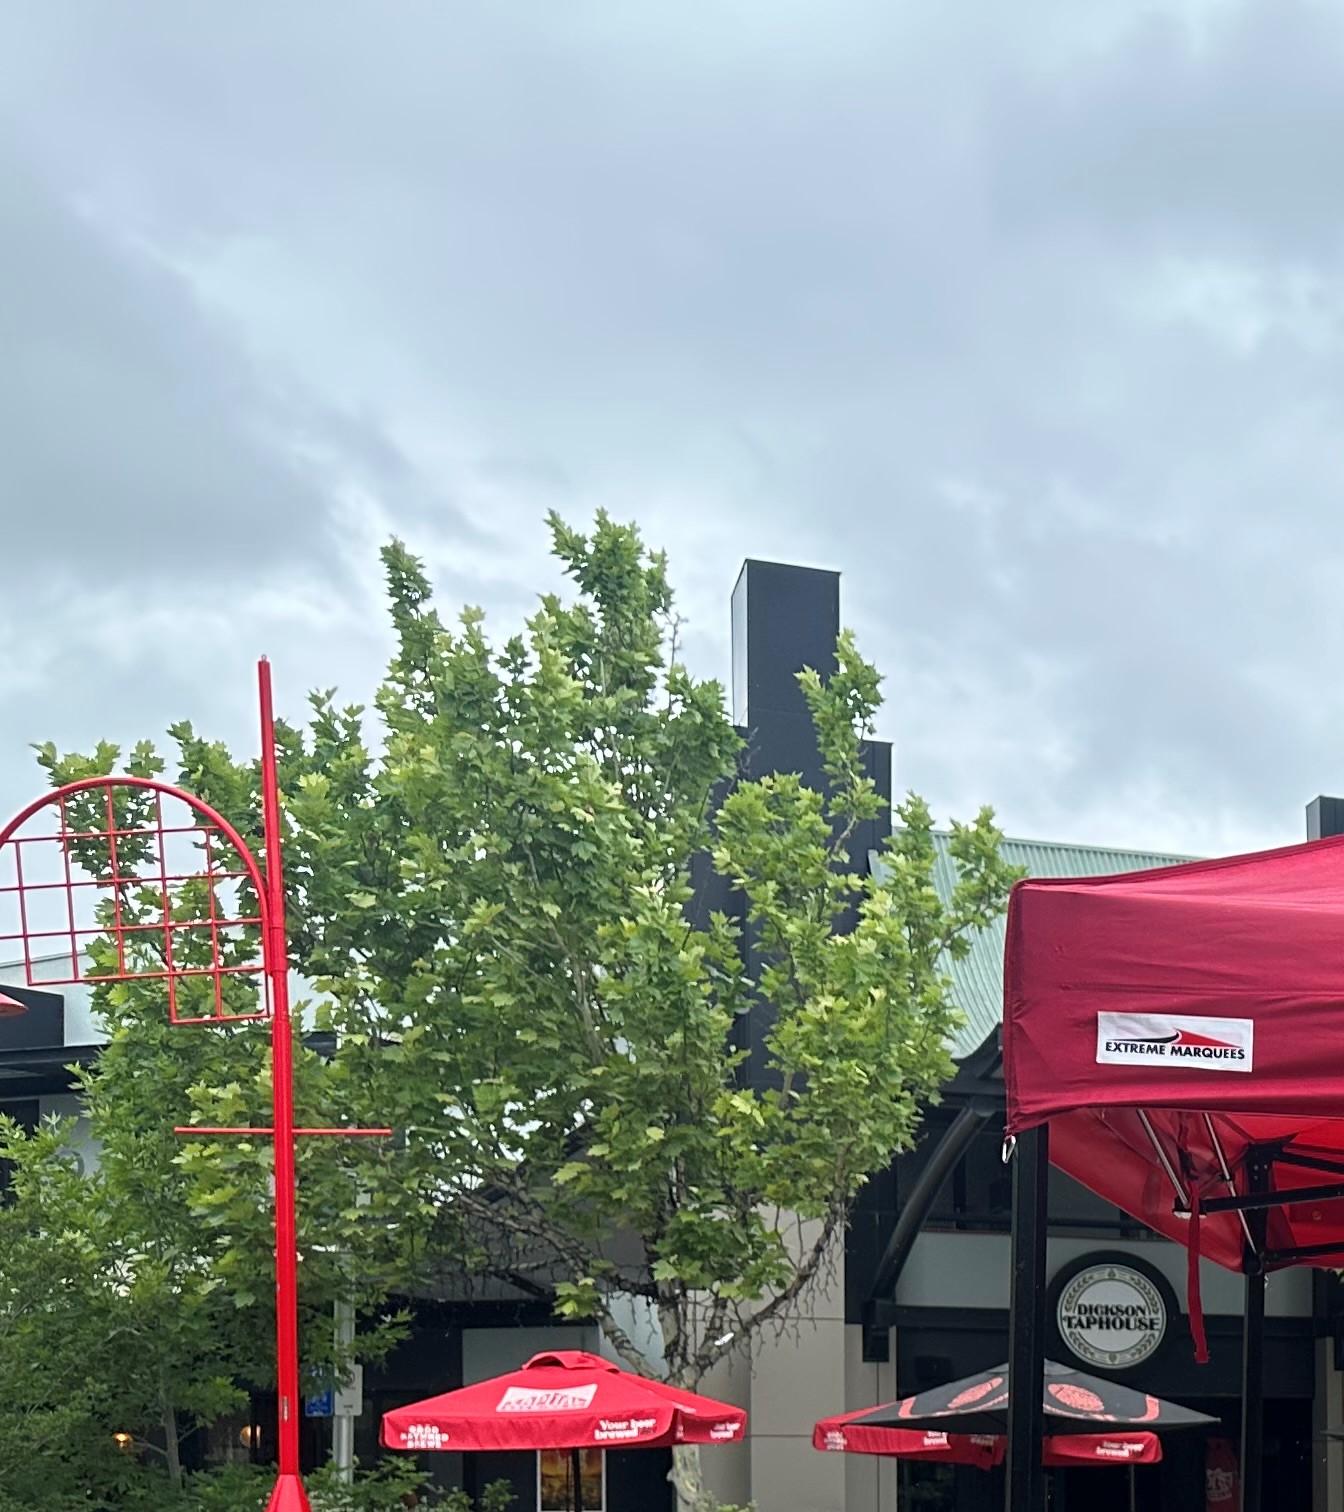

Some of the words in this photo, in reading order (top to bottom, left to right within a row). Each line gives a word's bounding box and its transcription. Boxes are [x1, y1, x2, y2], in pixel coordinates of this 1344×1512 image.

[1105, 1041, 1166, 1055] EXTREME
[1170, 1045, 1246, 1060] MARQUEES
[1077, 1304, 1146, 1316] DICKSON
[1062, 1315, 1160, 1331] TAPHOUSE
[599, 1419, 629, 1430] Your
[630, 1418, 656, 1429] beer
[594, 1428, 639, 1441] brewed
